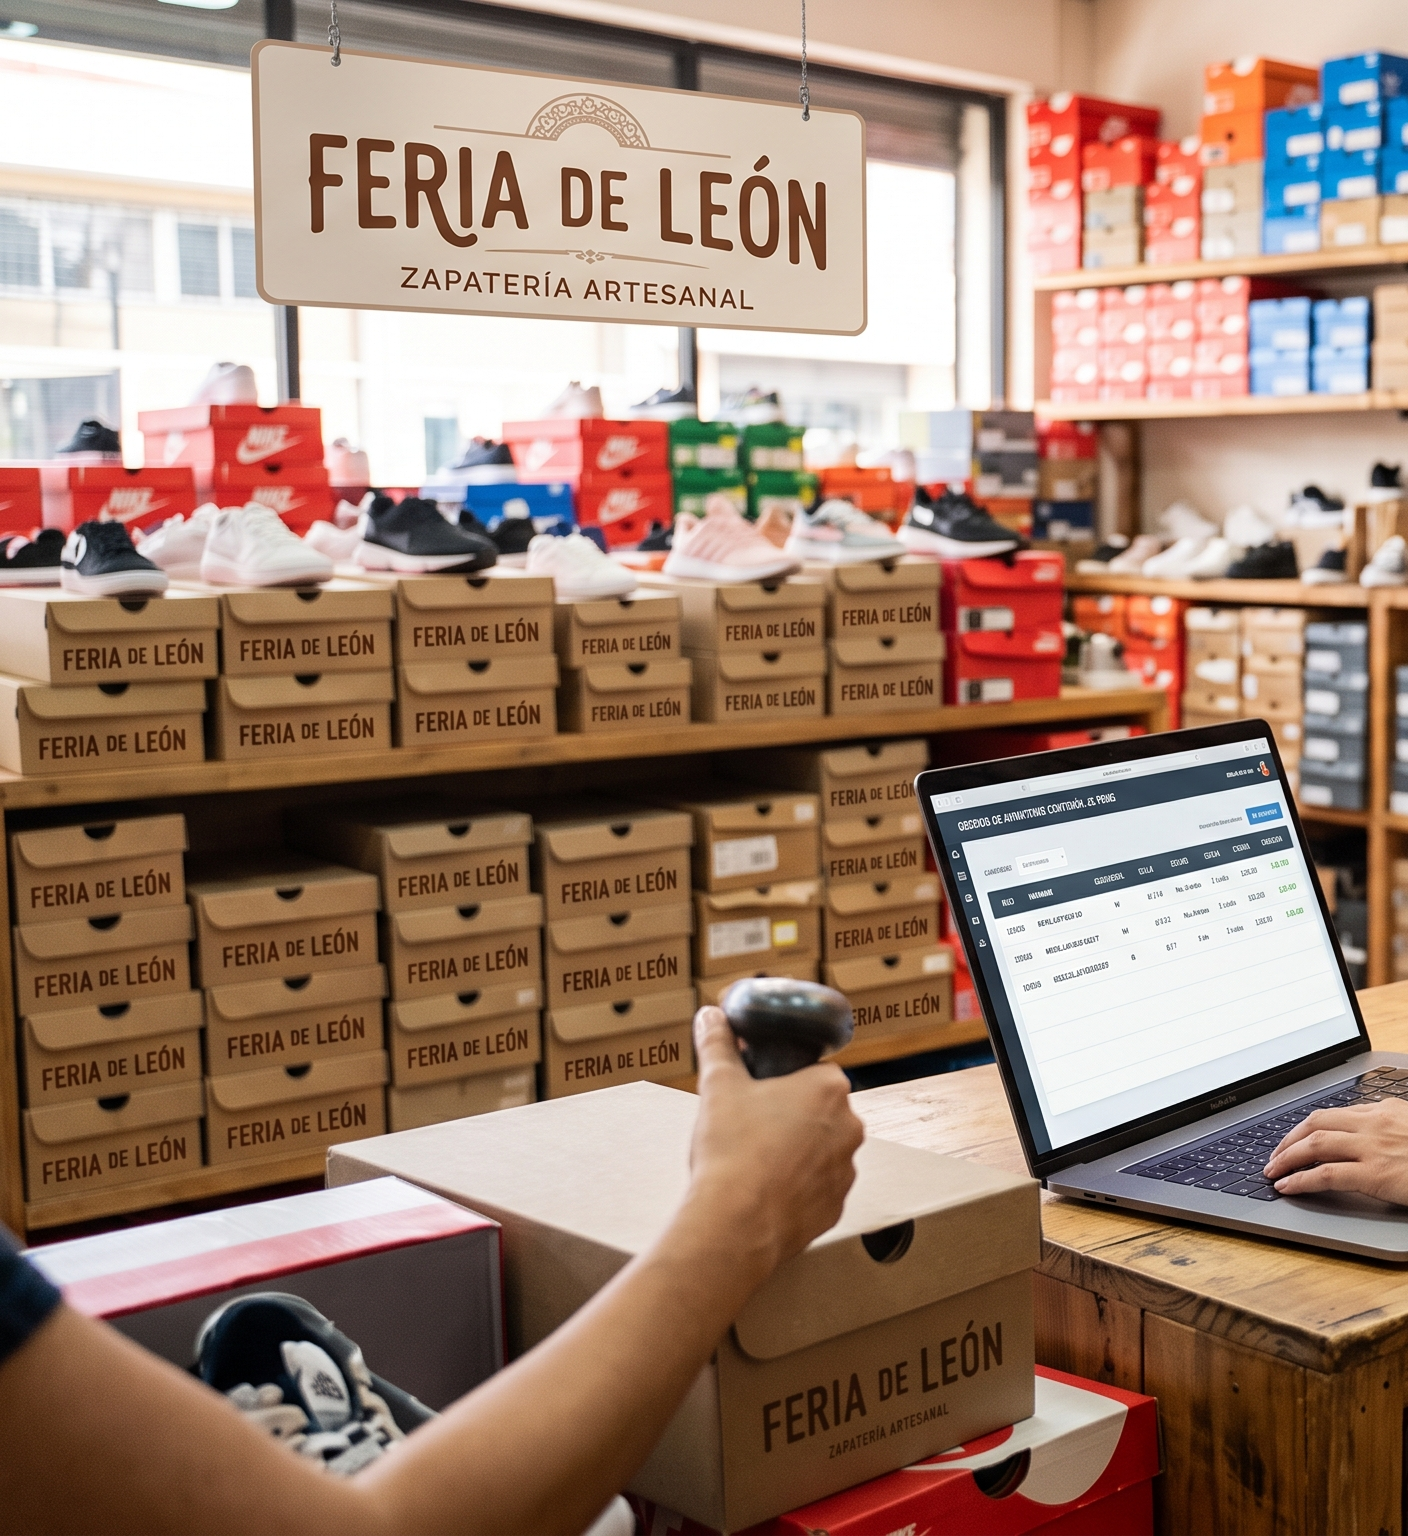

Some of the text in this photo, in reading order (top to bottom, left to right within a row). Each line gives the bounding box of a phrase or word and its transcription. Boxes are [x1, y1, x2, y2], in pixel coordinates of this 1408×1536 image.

[309, 130, 826, 270] FERIA DE LEÓN
[401, 267, 753, 310] ZAPATERÍA ARTESANAL
[414, 618, 539, 647] FERIA DE LEÓN
[726, 618, 815, 641] FERIA DE LEÓN
[843, 603, 931, 626] FERIA DE LEÓN
[64, 638, 203, 670] FERIA DE LEÓN
[240, 630, 374, 661] FERIA DE LEÓN
[582, 631, 670, 654] FERIA DE LEÓN
[726, 687, 815, 711] FERIA DE LEÓN
[842, 676, 933, 701] FERIA DE LEÓN
[416, 700, 540, 733] FERIA DE LEÓN
[592, 698, 681, 722] FERIA DE LEÓN
[39, 725, 186, 760] FERIA DE LEÓN
[240, 713, 374, 746] FERIA DE LEÓN
[831, 788, 867, 806] FERIA
[871, 788, 882, 800] DE
[398, 860, 518, 897] FERIA DE LEÓN
[830, 848, 917, 877] FERIA DE LEÓN
[31, 869, 170, 908] FERIA DE LEÓN
[562, 867, 676, 904] FERIA DE LEÓN
[223, 927, 358, 968] FERIA DE LEÓN
[835, 916, 927, 949] FERIA DE LEÓN
[35, 956, 175, 998] FERIA DE LEÓN
[408, 944, 528, 984] FERIA DE LEÓN
[563, 953, 677, 993] FERIA DE LEÓN
[886, 1003, 900, 1018] DE
[904, 995, 940, 1017] LEÓN
[228, 1014, 364, 1059] FERIA DE LEÓN
[408, 1027, 528, 1069] FERIA DE LEÓN
[42, 1045, 185, 1091] FERIA DE LEÓN
[565, 1040, 679, 1081] FERIA DE LEÓN
[228, 1102, 366, 1149] FERIA DE LEÓN
[43, 1135, 186, 1184] FERIA DE LEÓN
[762, 1320, 1002, 1453] FERIA DE LEÓN
[829, 1403, 949, 1459] ZAPATERÍA ARTESANAL
